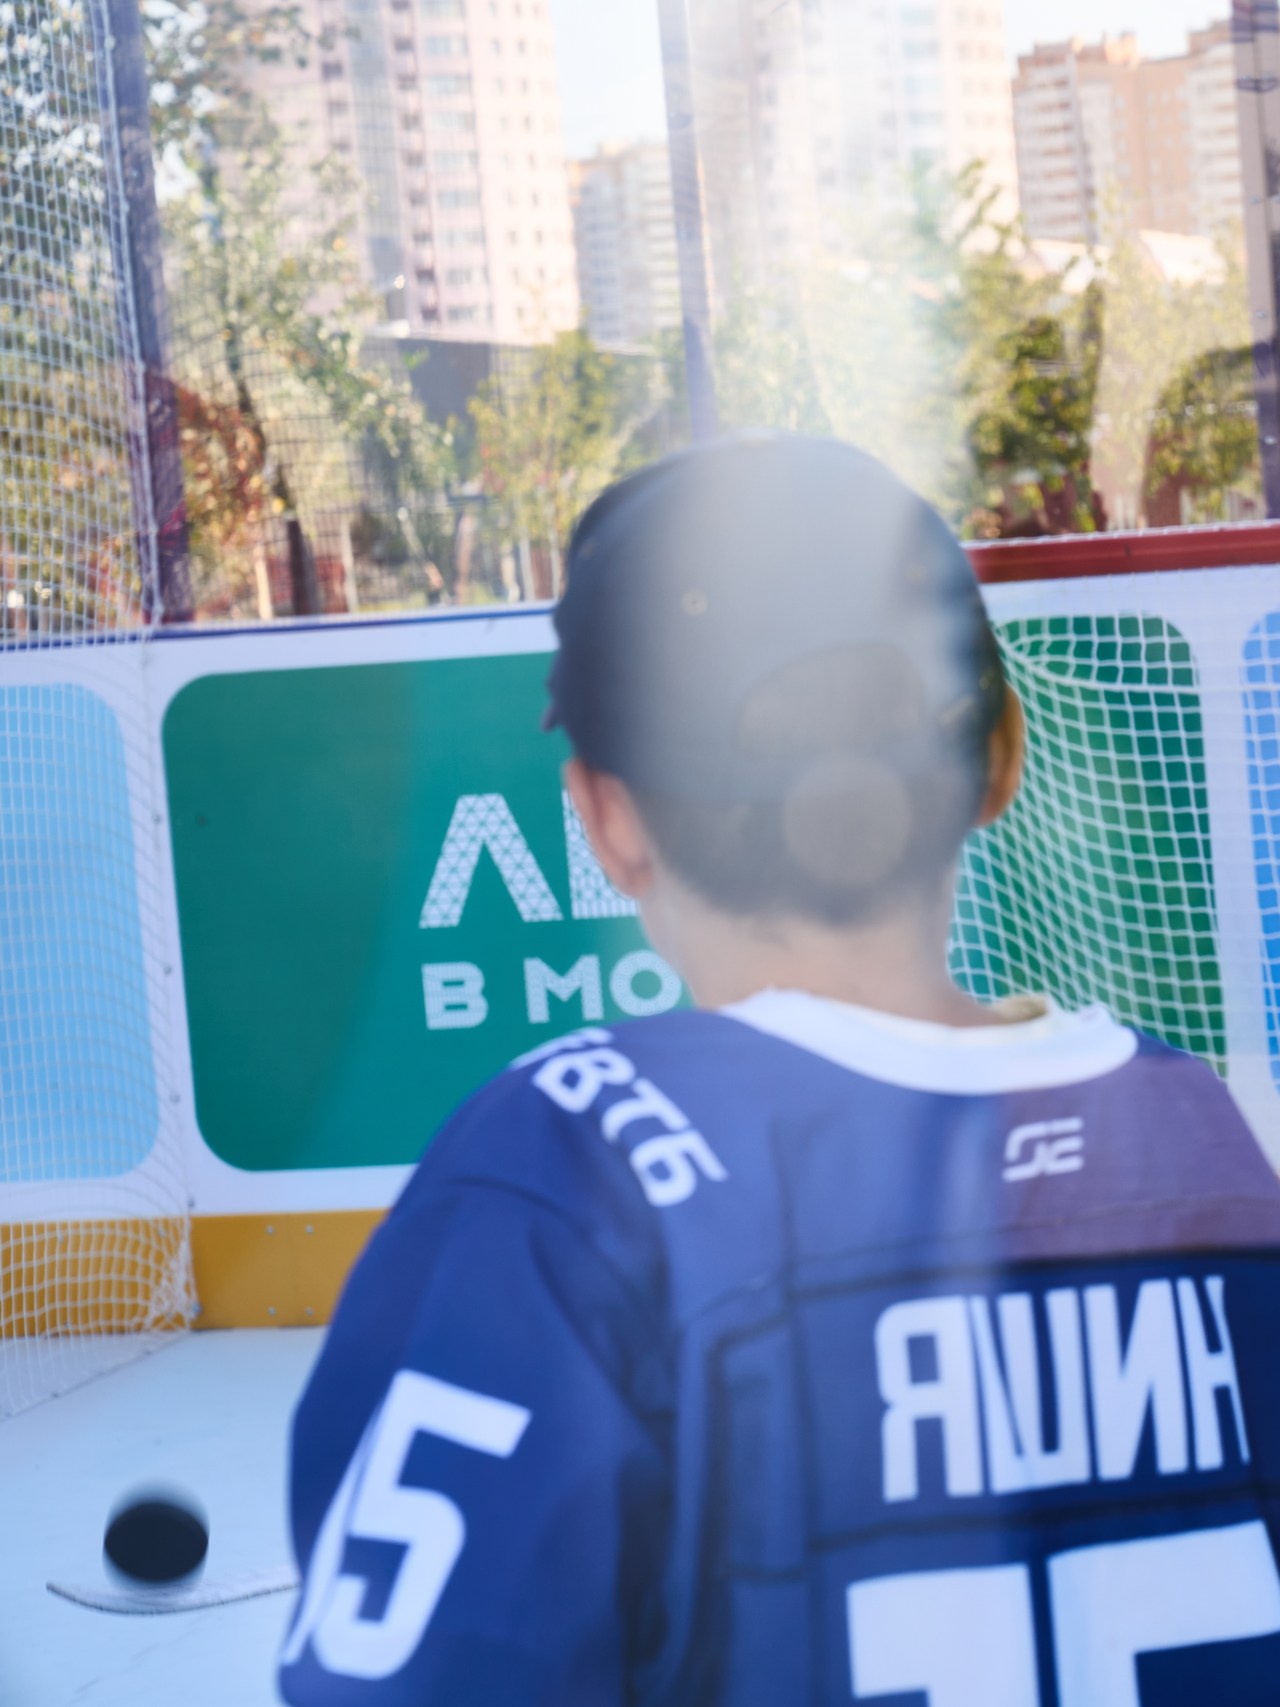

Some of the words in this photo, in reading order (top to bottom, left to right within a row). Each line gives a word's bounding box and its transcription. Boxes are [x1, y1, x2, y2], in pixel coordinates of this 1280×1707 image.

[421, 961, 489, 1030] В
[531, 1046, 730, 1207] ВТБ
[875, 1276, 1250, 1502] ЯШИН
